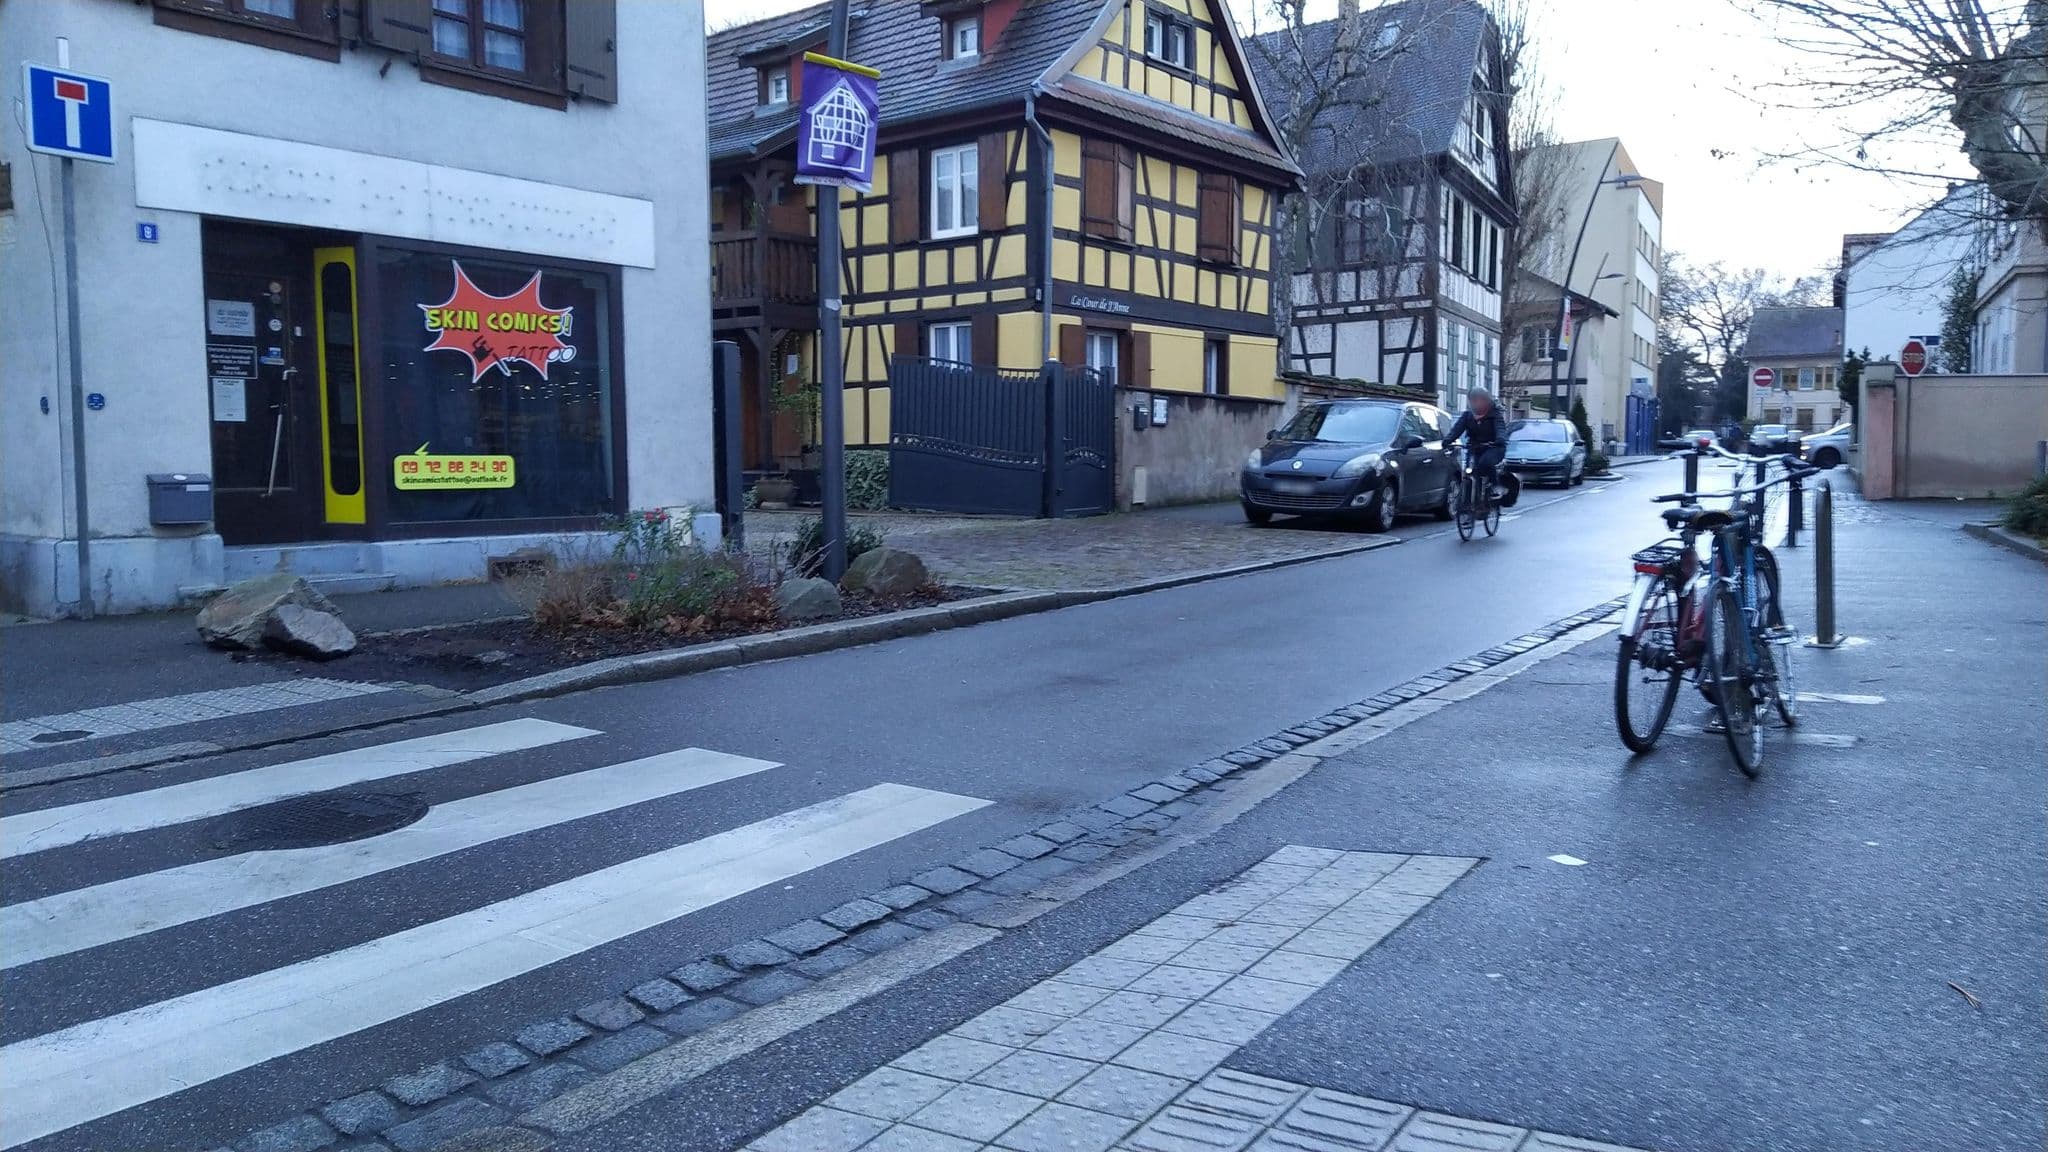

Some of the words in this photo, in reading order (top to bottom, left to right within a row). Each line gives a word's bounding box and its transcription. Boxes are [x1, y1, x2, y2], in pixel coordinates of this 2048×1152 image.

[1070, 295, 1081, 306] La
[1082, 296, 1099, 309] Cour
[1099, 298, 1108, 310] de
[427, 309, 480, 331] SKIN
[486, 312, 572, 335] COMICS!
[506, 345, 577, 363] TATTOO
[1903, 352, 1926, 364] STOP
[401, 461, 418, 474] 09
[425, 461, 442, 474] 72
[448, 461, 464, 473] 88
[470, 461, 486, 473] 24
[491, 461, 508, 473] 90
